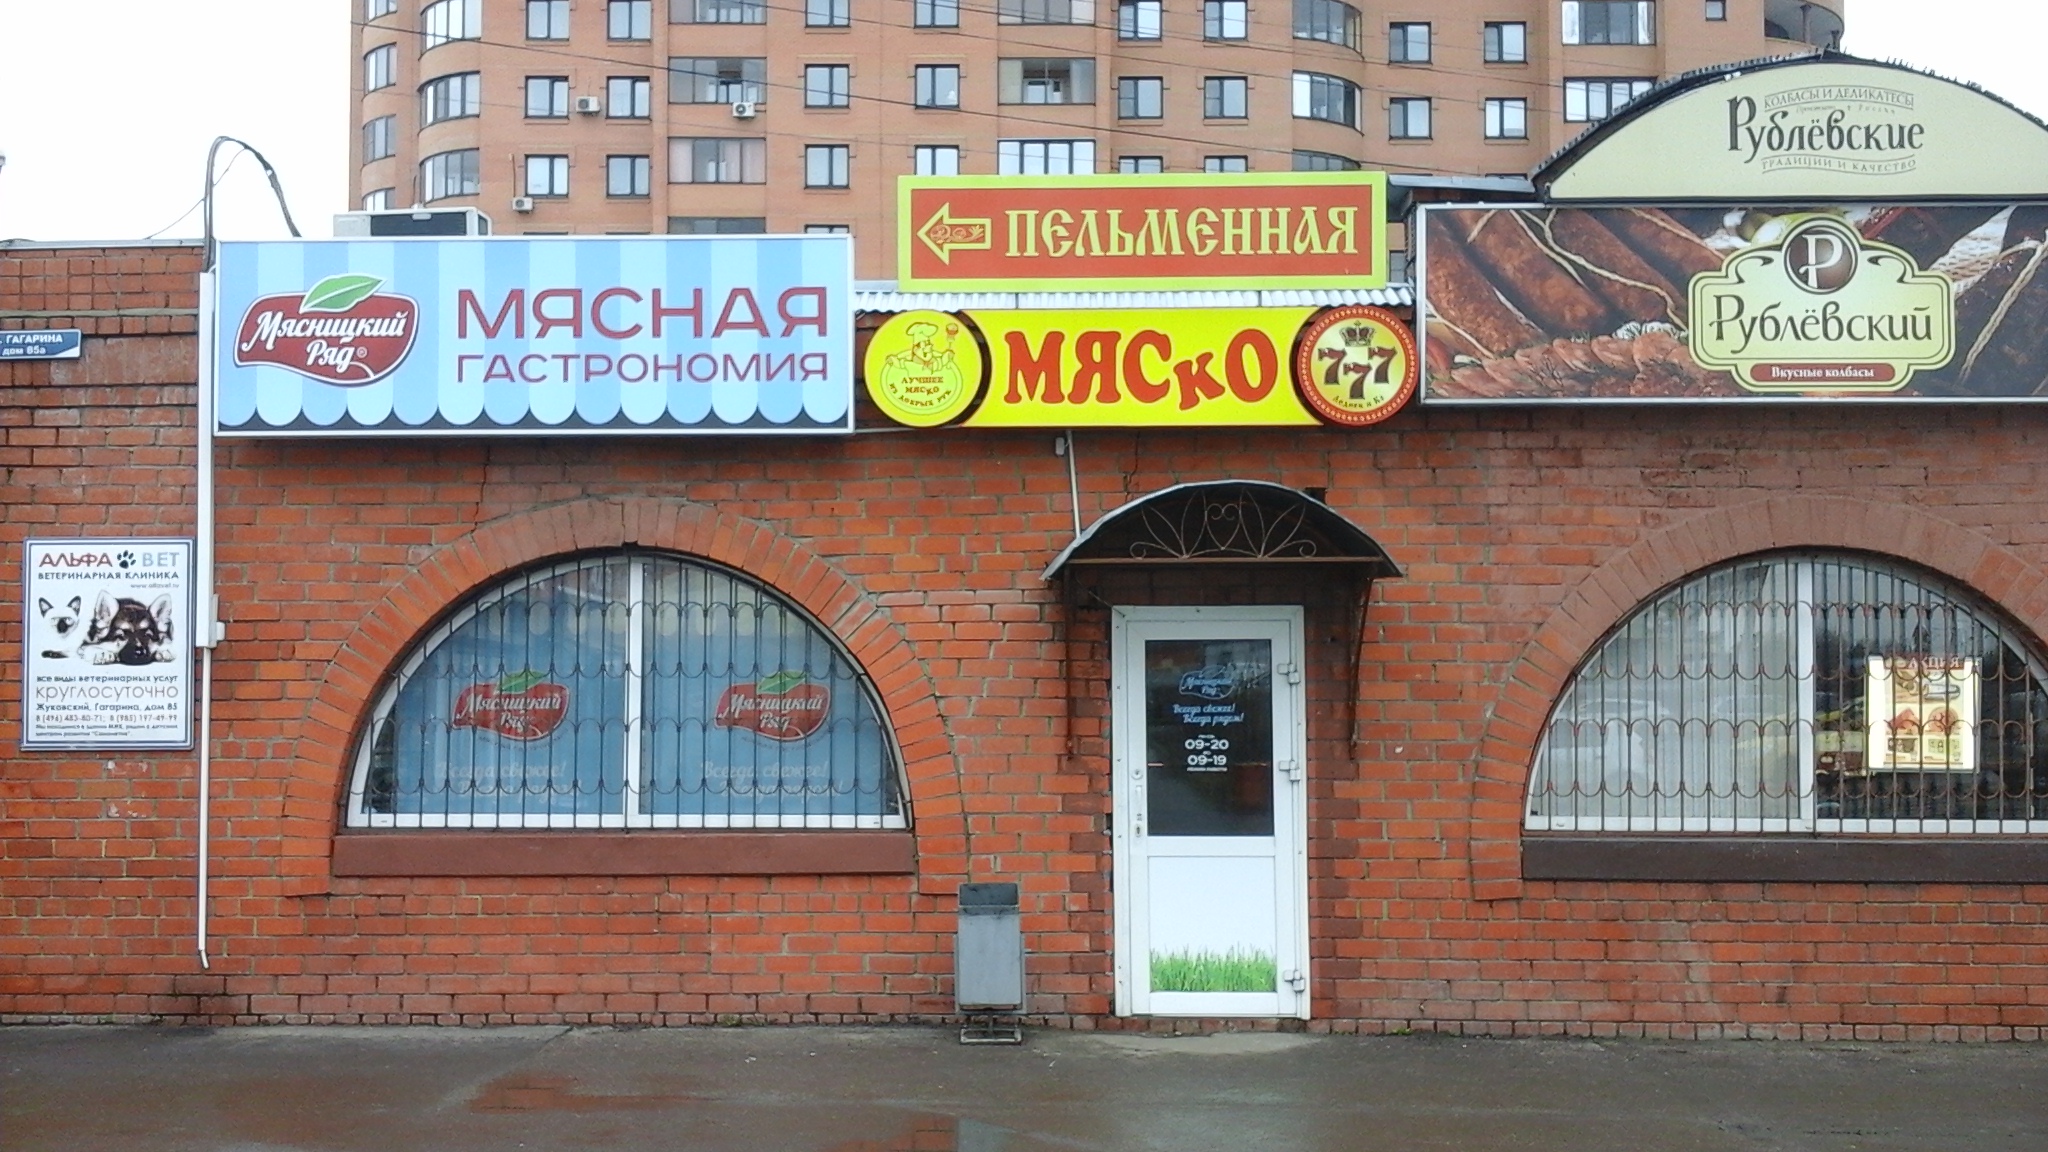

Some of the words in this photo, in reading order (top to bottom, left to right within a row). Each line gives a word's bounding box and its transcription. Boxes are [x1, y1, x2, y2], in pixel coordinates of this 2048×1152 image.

[1764, 89, 1819, 108] КОЛБАСЫ
[1822, 89, 1832, 99] И
[1834, 88, 1914, 106] ДЕЛИКАТЕСЫ
[1727, 96, 1924, 163] Рублёвские
[1762, 157, 1832, 170] ТРАДИЦИИ
[1838, 159, 1846, 170] И
[1853, 159, 1916, 173] КАЧЕСТВО
[1005, 206, 1358, 257] ПЕЛЬМЕННАЯ
[458, 287, 828, 339] МЯСНАЯ
[241, 310, 409, 352] Мясницкий
[1709, 294, 1932, 354] Рублёвский
[6, 334, 63, 343] ГАГАРИНА
[306, 339, 355, 373] Ряд
[457, 353, 828, 383] ГАСТРОНОМИЯ
[1772, 366, 1822, 379] Вкусные
[1825, 366, 1874, 378] колбасы
[39, 552, 113, 568] АЛЬФА
[142, 552, 180, 567] ВЕТ
[38, 572, 122, 580] ВЕТЕРИНАРНАЯ
[125, 571, 179, 580] КЛИНИКА
[153, 675, 178, 683] услуг
[36, 686, 178, 702] круглосуточно
[167, 703, 177, 711] 85
[1185, 739, 1229, 750] 09-20
[1187, 755, 1227, 766] 09-19
